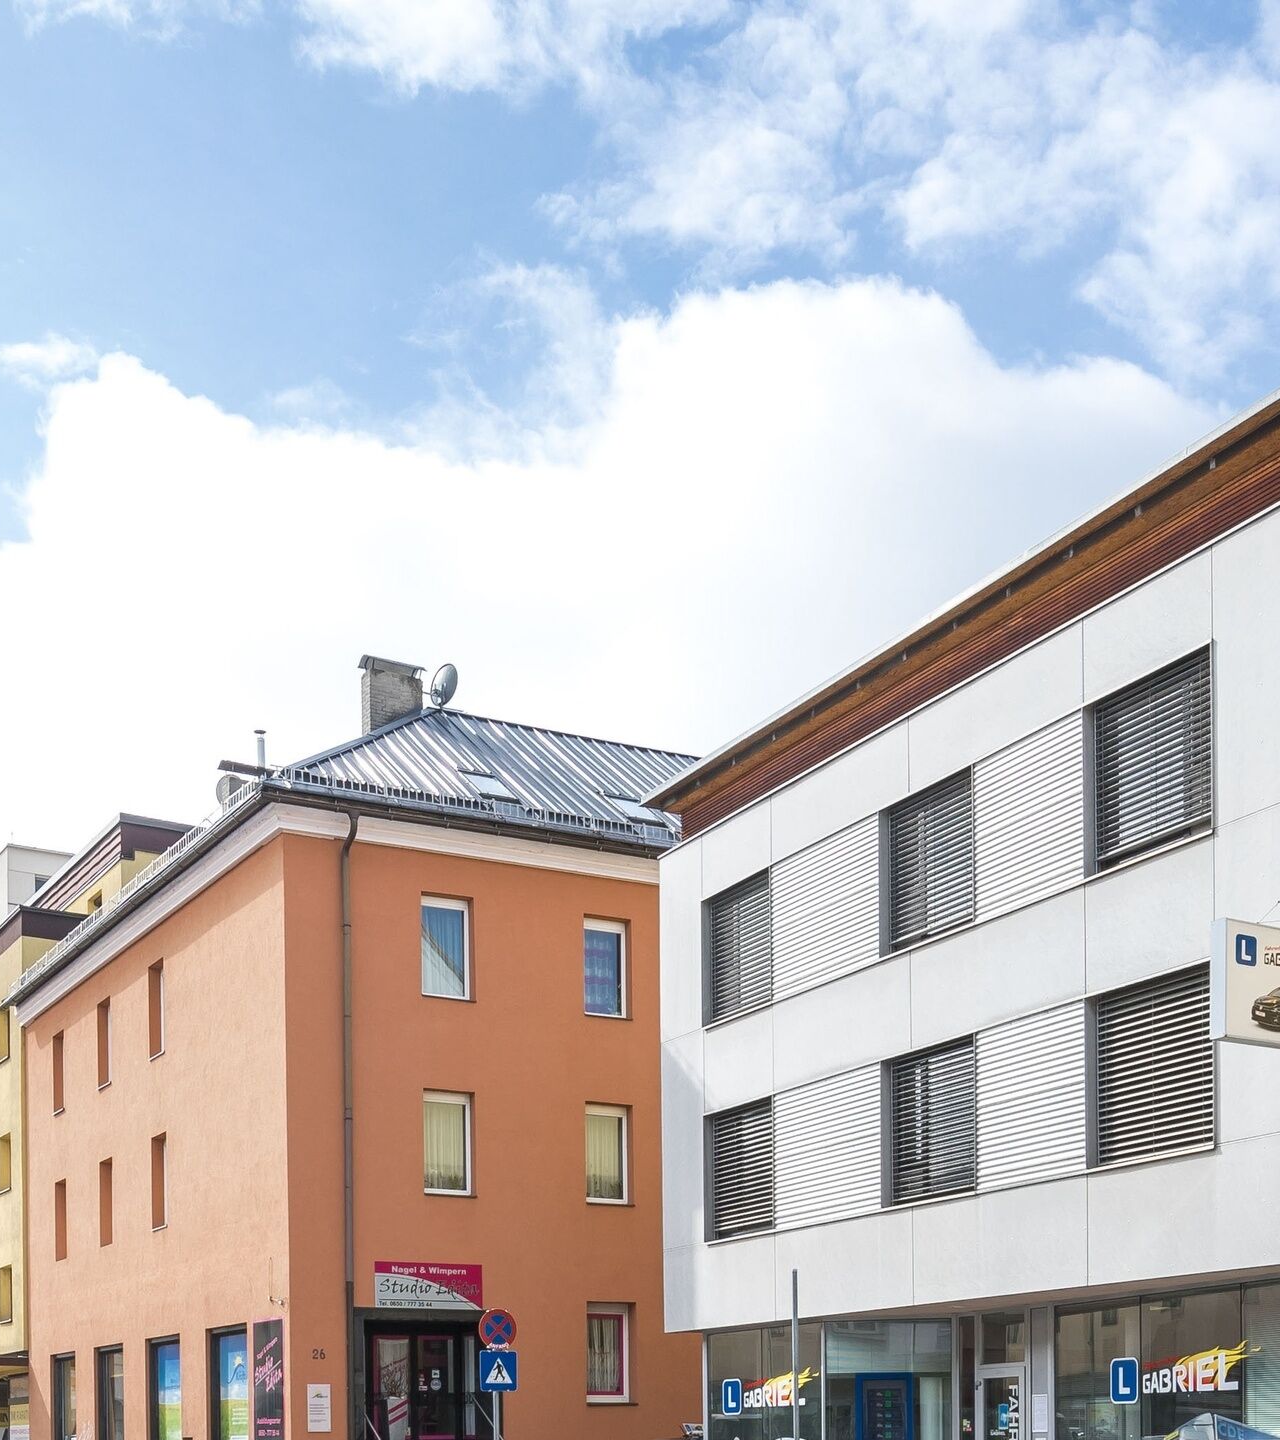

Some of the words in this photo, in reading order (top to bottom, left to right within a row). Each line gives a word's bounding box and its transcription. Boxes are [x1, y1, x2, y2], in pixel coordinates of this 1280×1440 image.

[1241, 939, 1252, 961] L
[391, 1265, 417, 1274] Nagel
[428, 1267, 467, 1275] Wimpern
[380, 1279, 431, 1298] Studio
[312, 1348, 326, 1360] 26
[1119, 1367, 1130, 1394] L
[1143, 1353, 1239, 1394] GABRIEL
[728, 1386, 736, 1407] L
[1220, 1423, 1245, 1440] CDE
